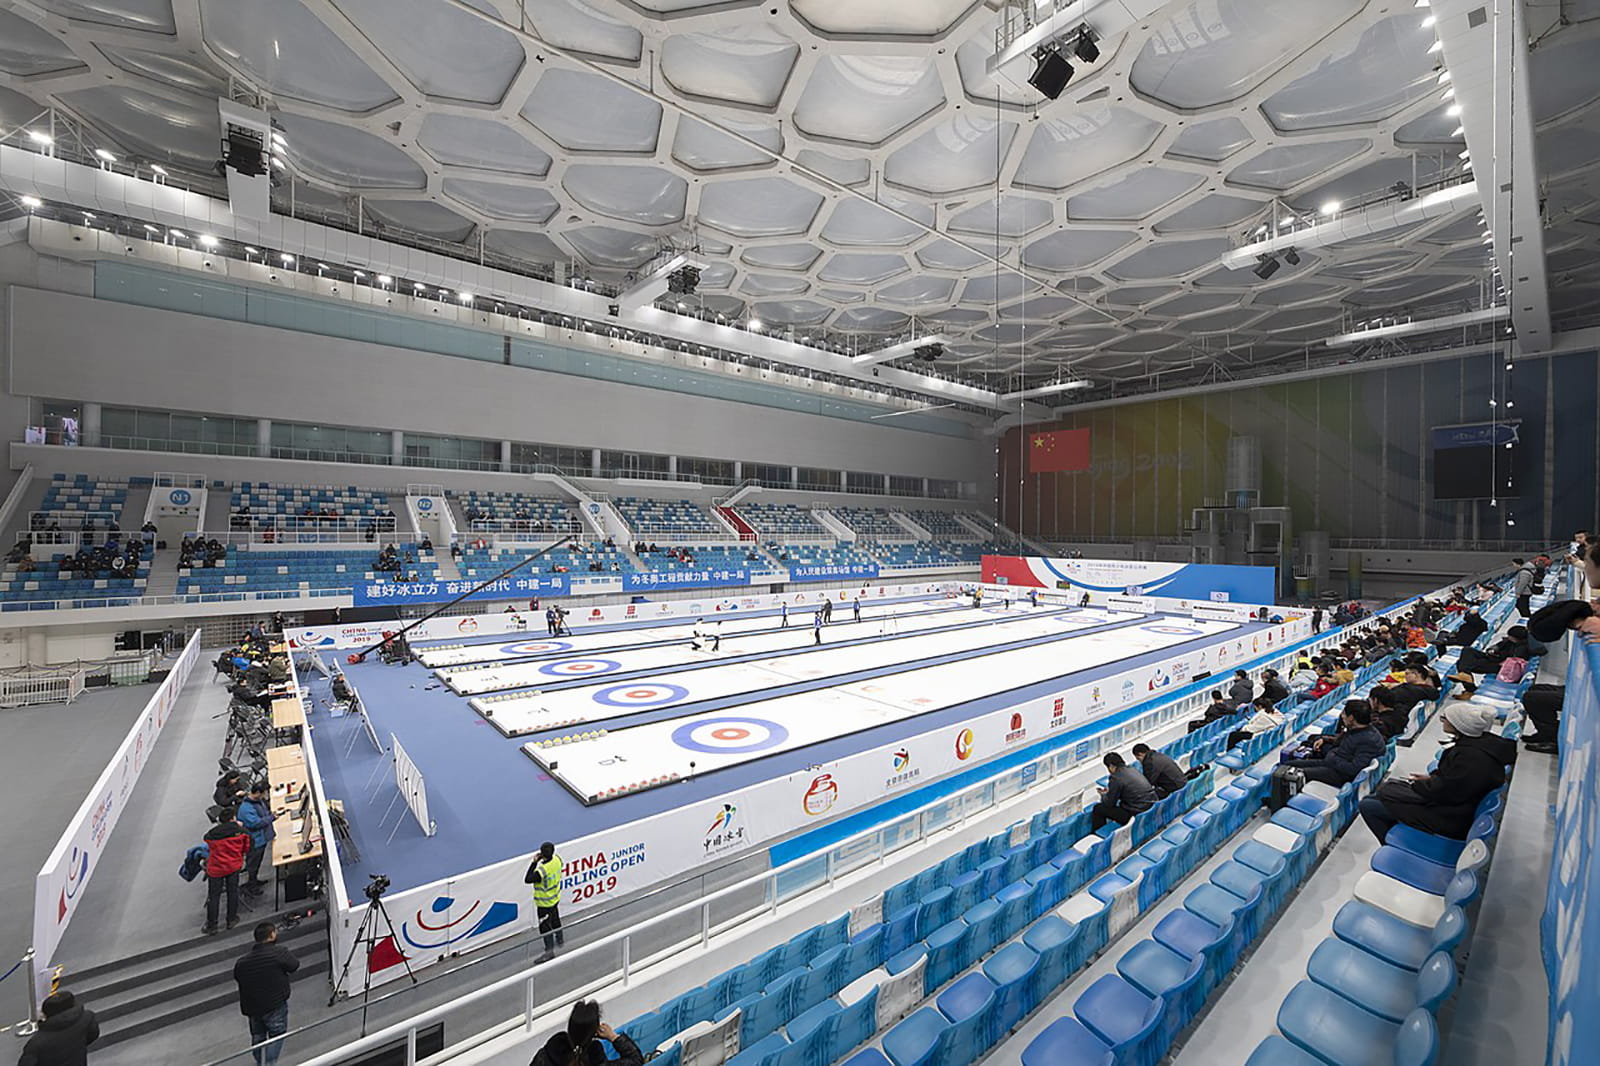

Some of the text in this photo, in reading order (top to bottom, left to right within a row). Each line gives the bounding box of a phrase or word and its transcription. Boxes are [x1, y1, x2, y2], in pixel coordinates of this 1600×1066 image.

[366, 577, 562, 598] 建好冰立方 奋进新时代 中建一局
[713, 570, 745, 581] 中建一局
[342, 627, 368, 635] CHINA
[560, 852, 645, 890] RLING OPEN
[561, 842, 645, 877] HINA JUNIOR
[572, 875, 617, 904] 2019
